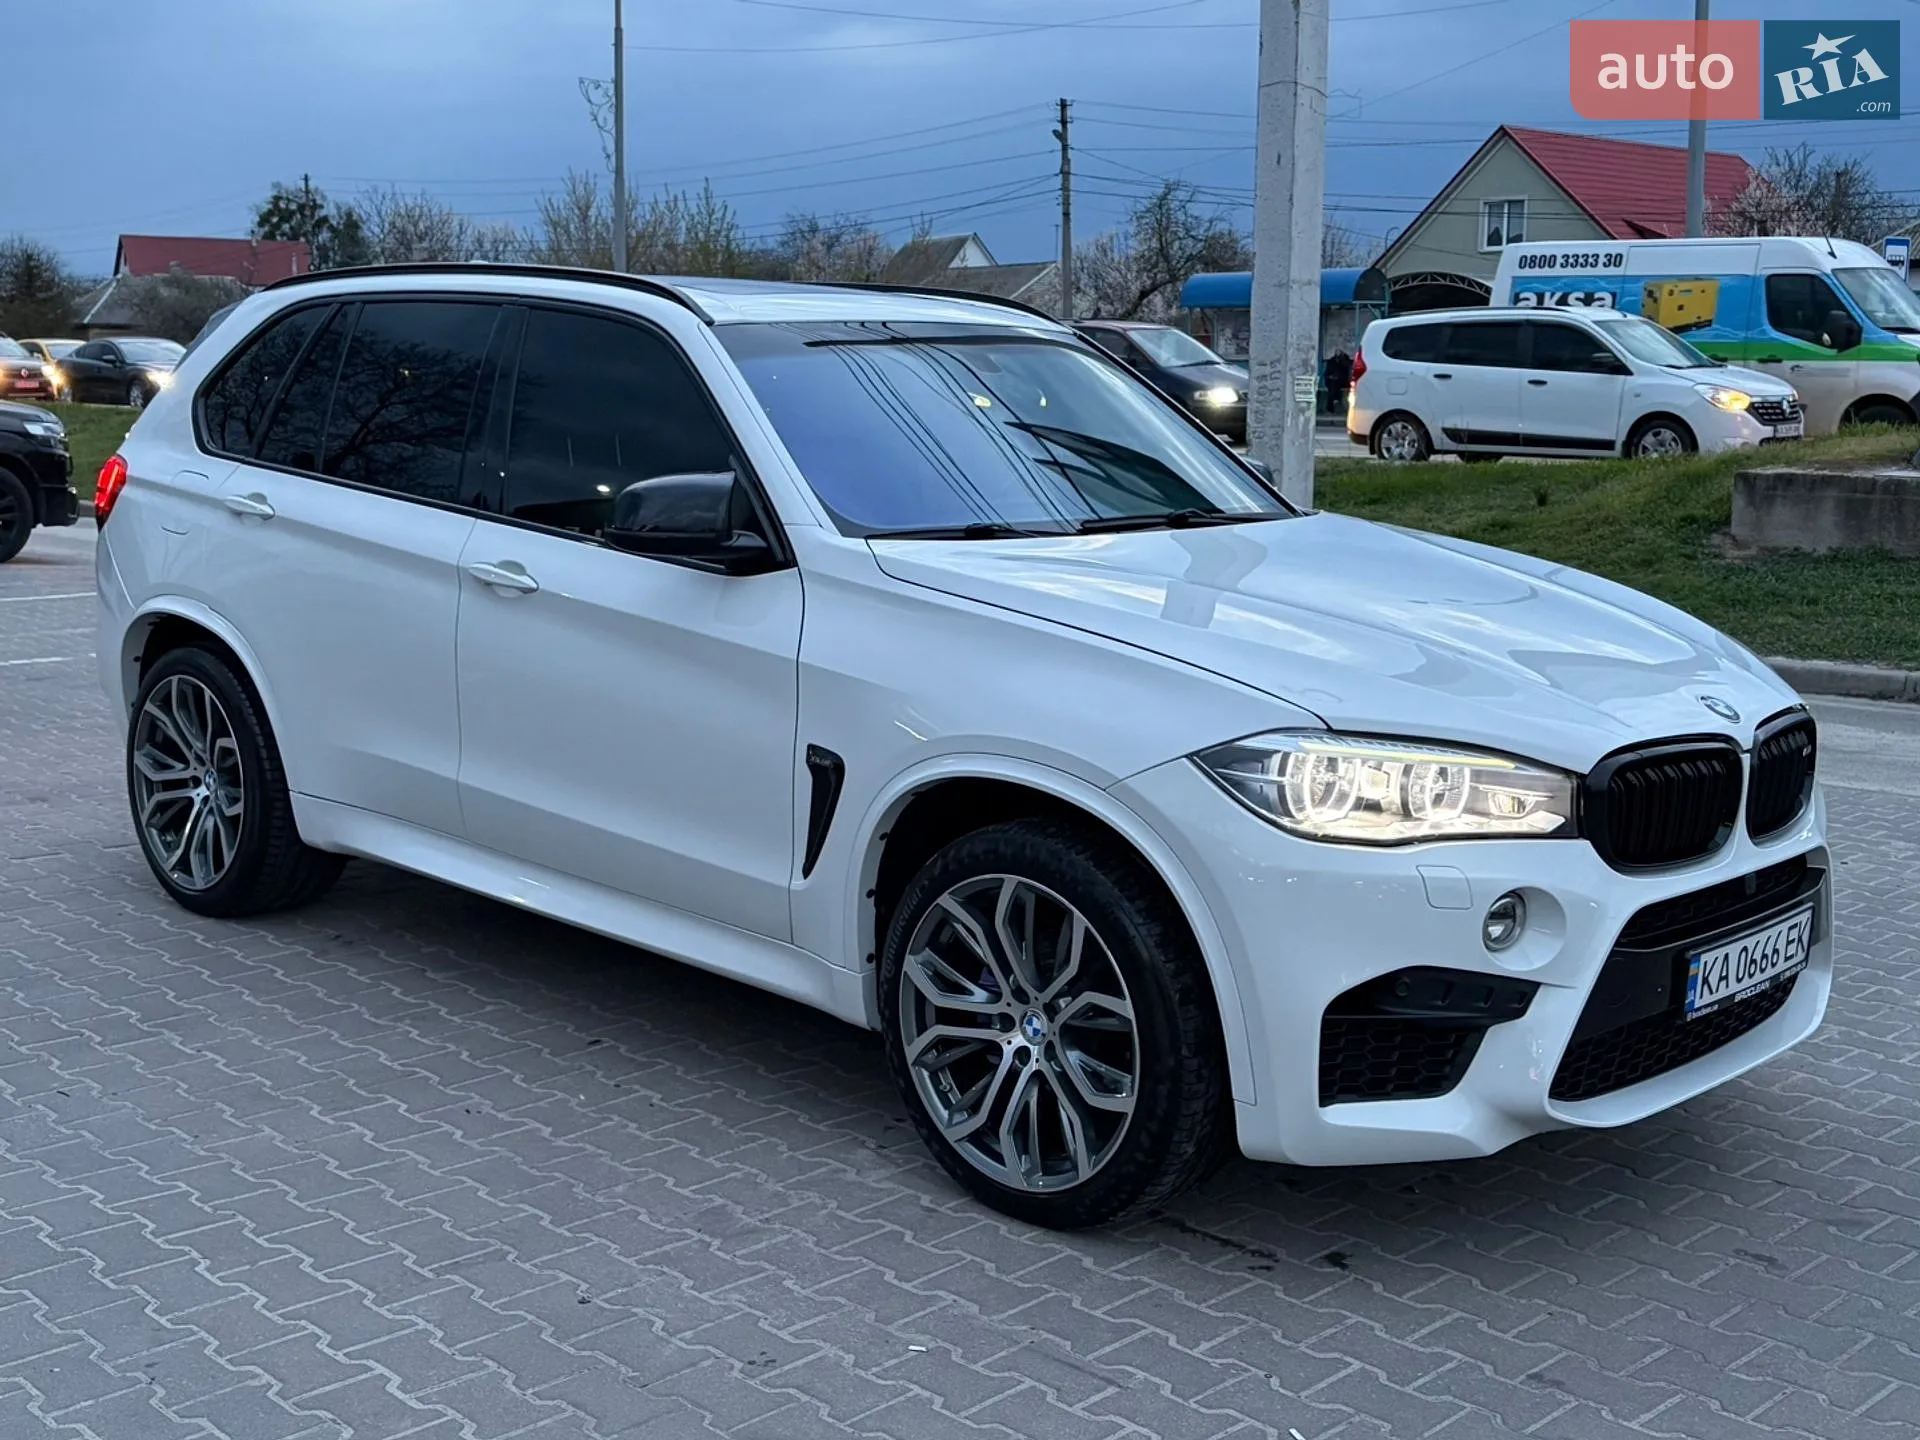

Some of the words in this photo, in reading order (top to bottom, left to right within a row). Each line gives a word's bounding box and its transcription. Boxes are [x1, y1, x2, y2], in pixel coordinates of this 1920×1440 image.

[1518, 254, 1557, 269] 0800
[1560, 253, 1600, 269] 3333
[1602, 253, 1624, 268] 30
[1700, 952, 1729, 1000] KA
[1736, 930, 1782, 984] 0666
[1784, 917, 1810, 963] EK
